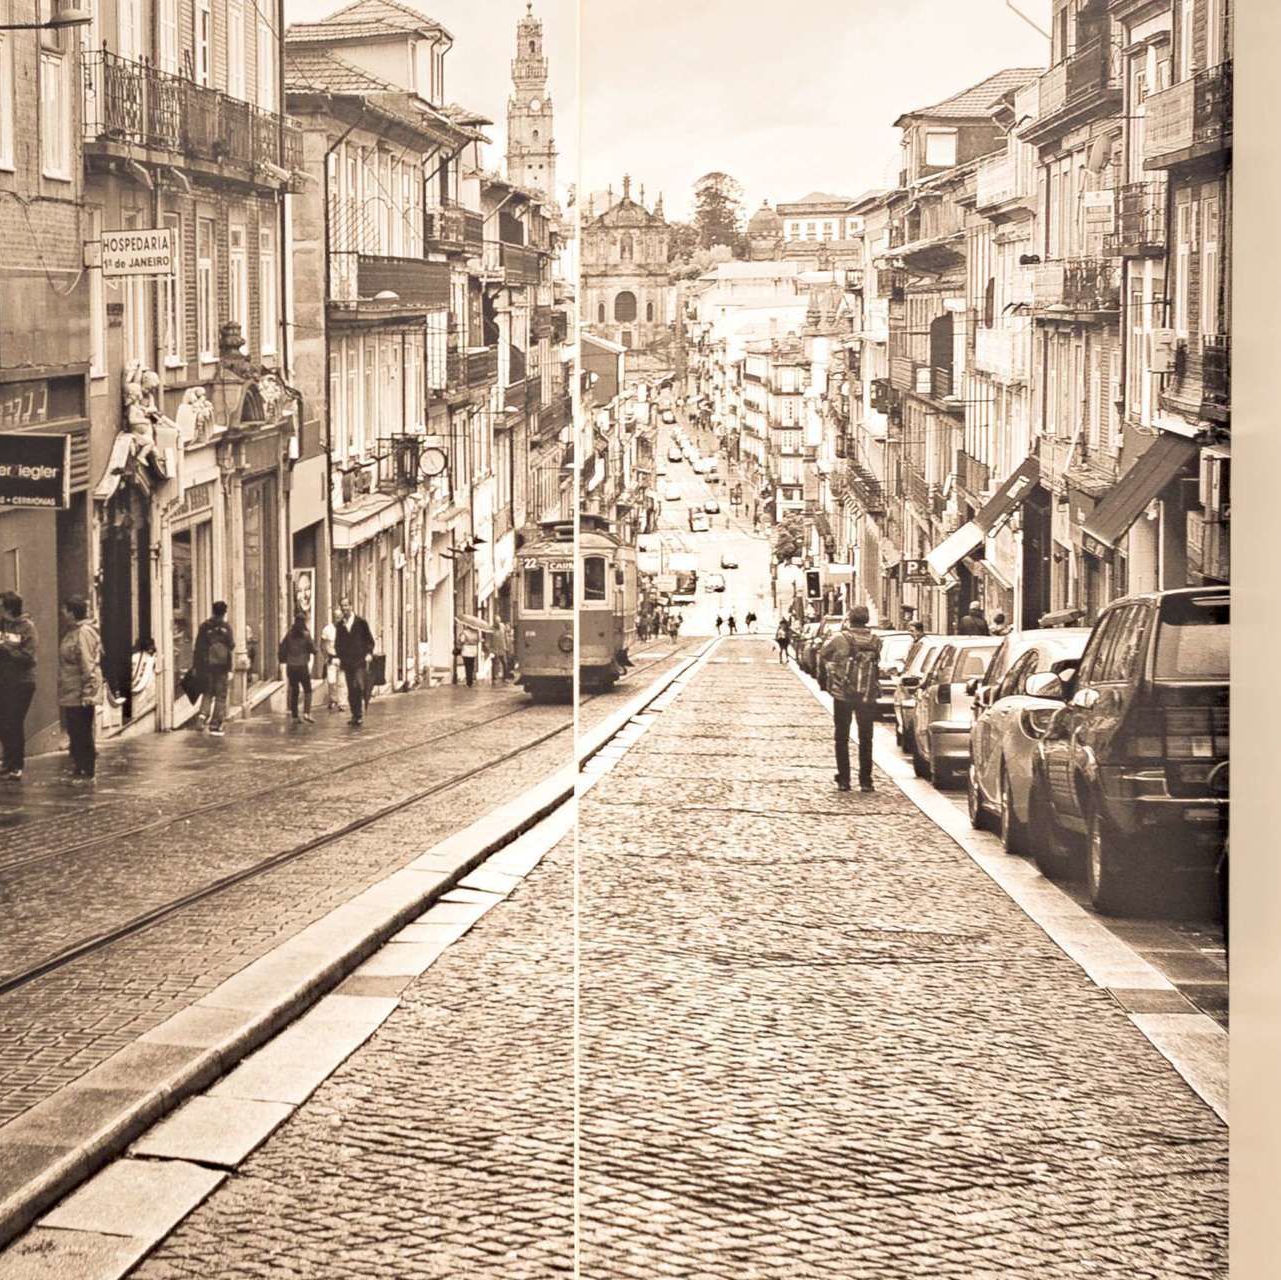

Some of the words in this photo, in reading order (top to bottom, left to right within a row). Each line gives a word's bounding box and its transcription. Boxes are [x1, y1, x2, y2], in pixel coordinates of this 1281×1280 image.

[103, 236, 169, 252] HOSPEDARIA
[115, 260, 126, 269] de
[129, 256, 170, 268] JANEIRO
[524, 558, 536, 569] 22
